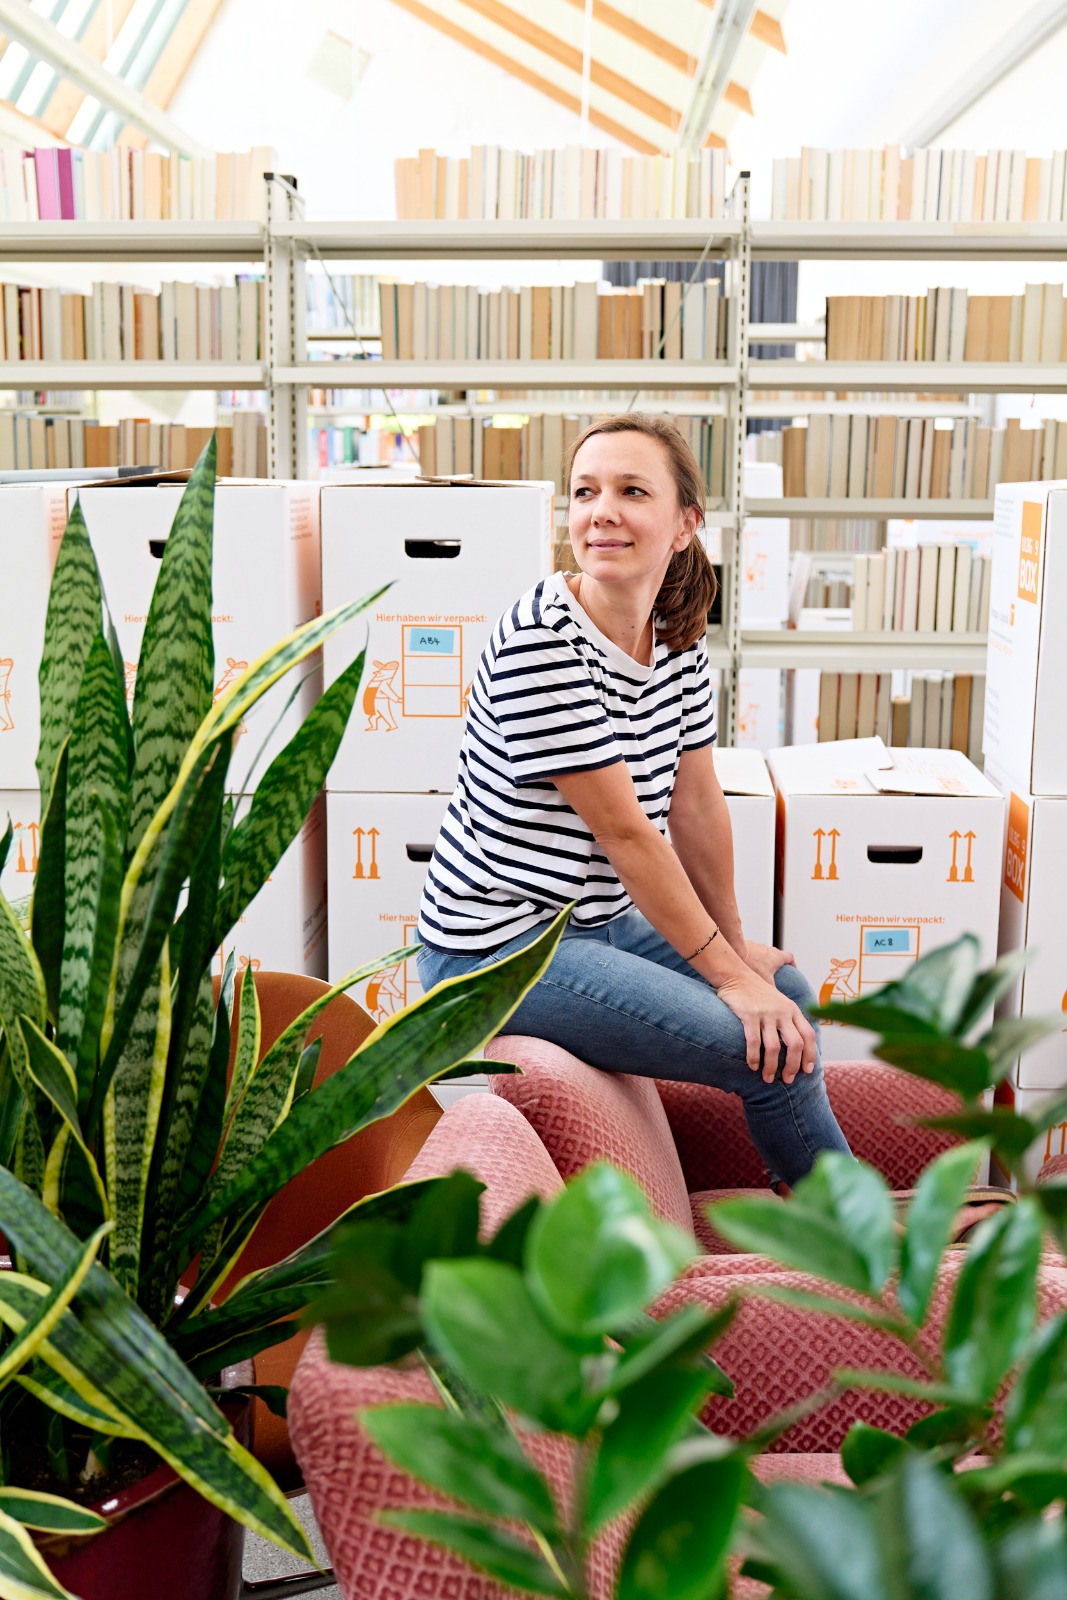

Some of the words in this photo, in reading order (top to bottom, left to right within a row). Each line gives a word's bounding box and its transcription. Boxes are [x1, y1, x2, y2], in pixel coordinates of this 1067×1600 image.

[1019, 558, 1038, 594] BOX
[124, 614, 142, 622] Hier
[211, 614, 234, 623] ackt:
[376, 613, 394, 622] Hier
[396, 613, 426, 622] haben
[428, 614, 441, 622] wir
[443, 614, 488, 624] verpackt:
[1007, 847, 1024, 891] BOX
[379, 913, 397, 922] Hier
[836, 914, 854, 922] Hier
[856, 914, 885, 923] haben
[886, 915, 900, 923] wir
[902, 915, 945, 925] verpackt:
